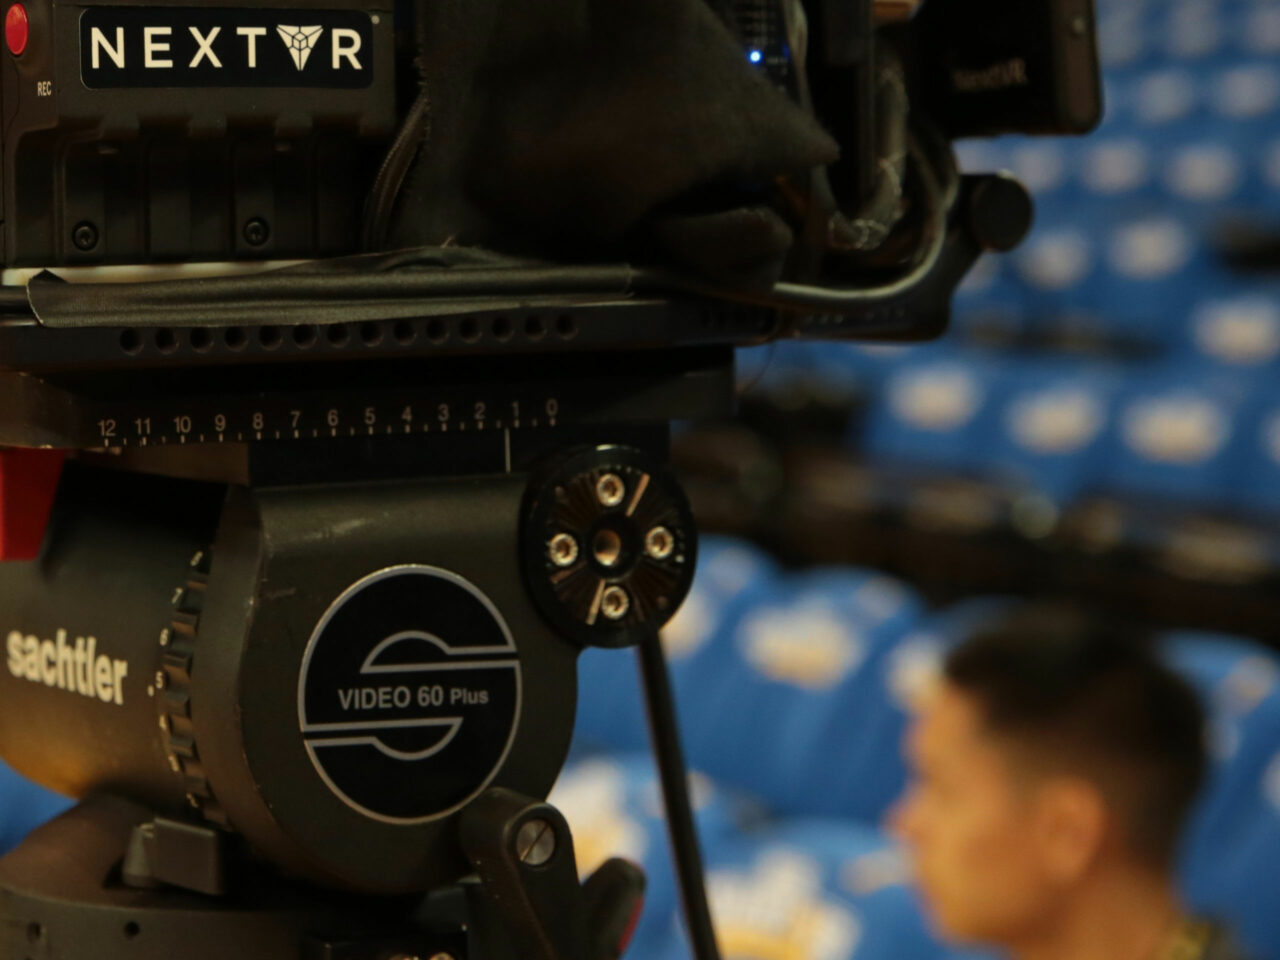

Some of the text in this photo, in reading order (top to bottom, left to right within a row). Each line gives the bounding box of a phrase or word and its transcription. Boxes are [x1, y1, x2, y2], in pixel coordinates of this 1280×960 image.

[37, 81, 52, 96] REC
[98, 398, 559, 437] 12 11 10 9 8 7 6 5 4 3 2 1 0
[6, 627, 128, 706] sachtler
[337, 685, 490, 711] VIDEO 60 Plus
